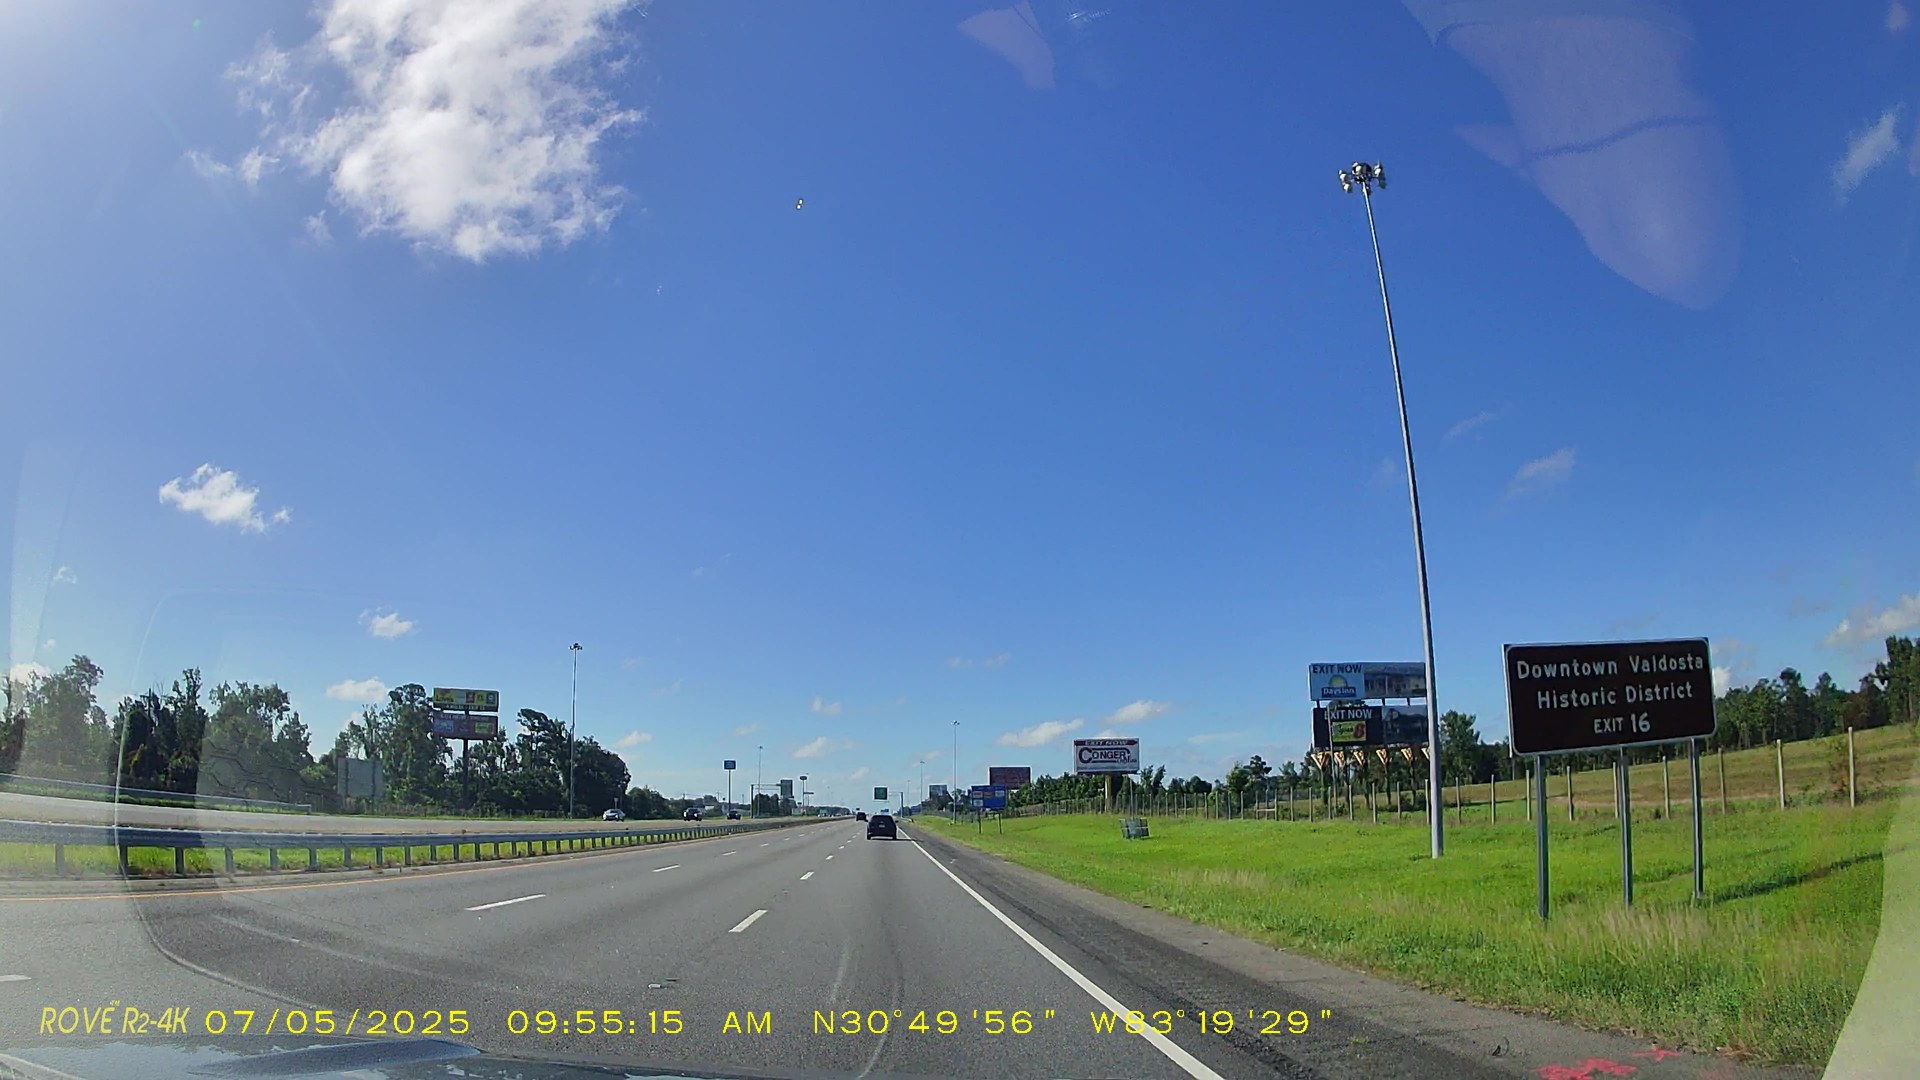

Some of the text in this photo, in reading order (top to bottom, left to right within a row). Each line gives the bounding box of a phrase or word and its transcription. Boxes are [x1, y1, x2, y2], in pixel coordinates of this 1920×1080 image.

[1312, 664, 1362, 674] EXIT NOW
[1517, 653, 1704, 679] Downtown Valdosta
[1537, 681, 1693, 709] Historic District
[1324, 709, 1372, 720] EXIT NOW
[1594, 713, 1650, 734] EXIT 16
